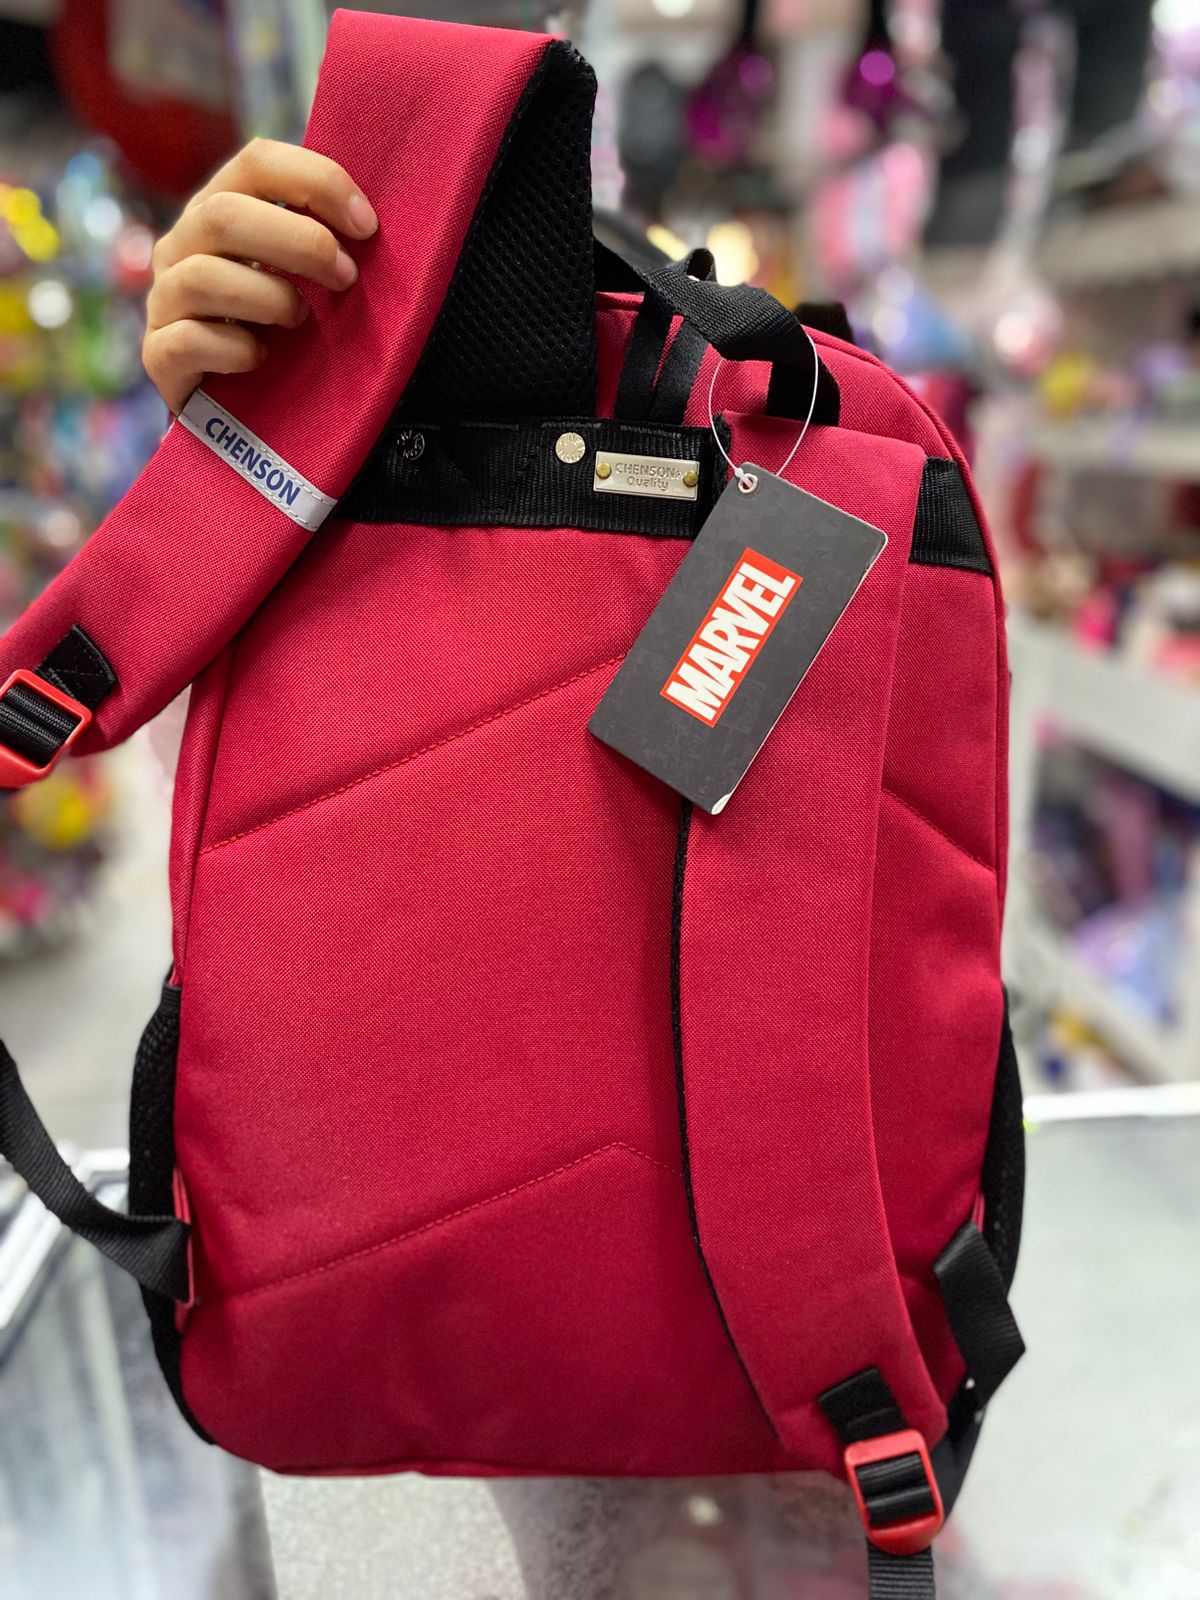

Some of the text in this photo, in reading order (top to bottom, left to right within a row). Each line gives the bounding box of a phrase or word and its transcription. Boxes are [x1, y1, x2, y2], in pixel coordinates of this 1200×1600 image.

[205, 417, 301, 506] CHENSON
[626, 476, 669, 491] Quality
[665, 562, 797, 722] MARVEL
